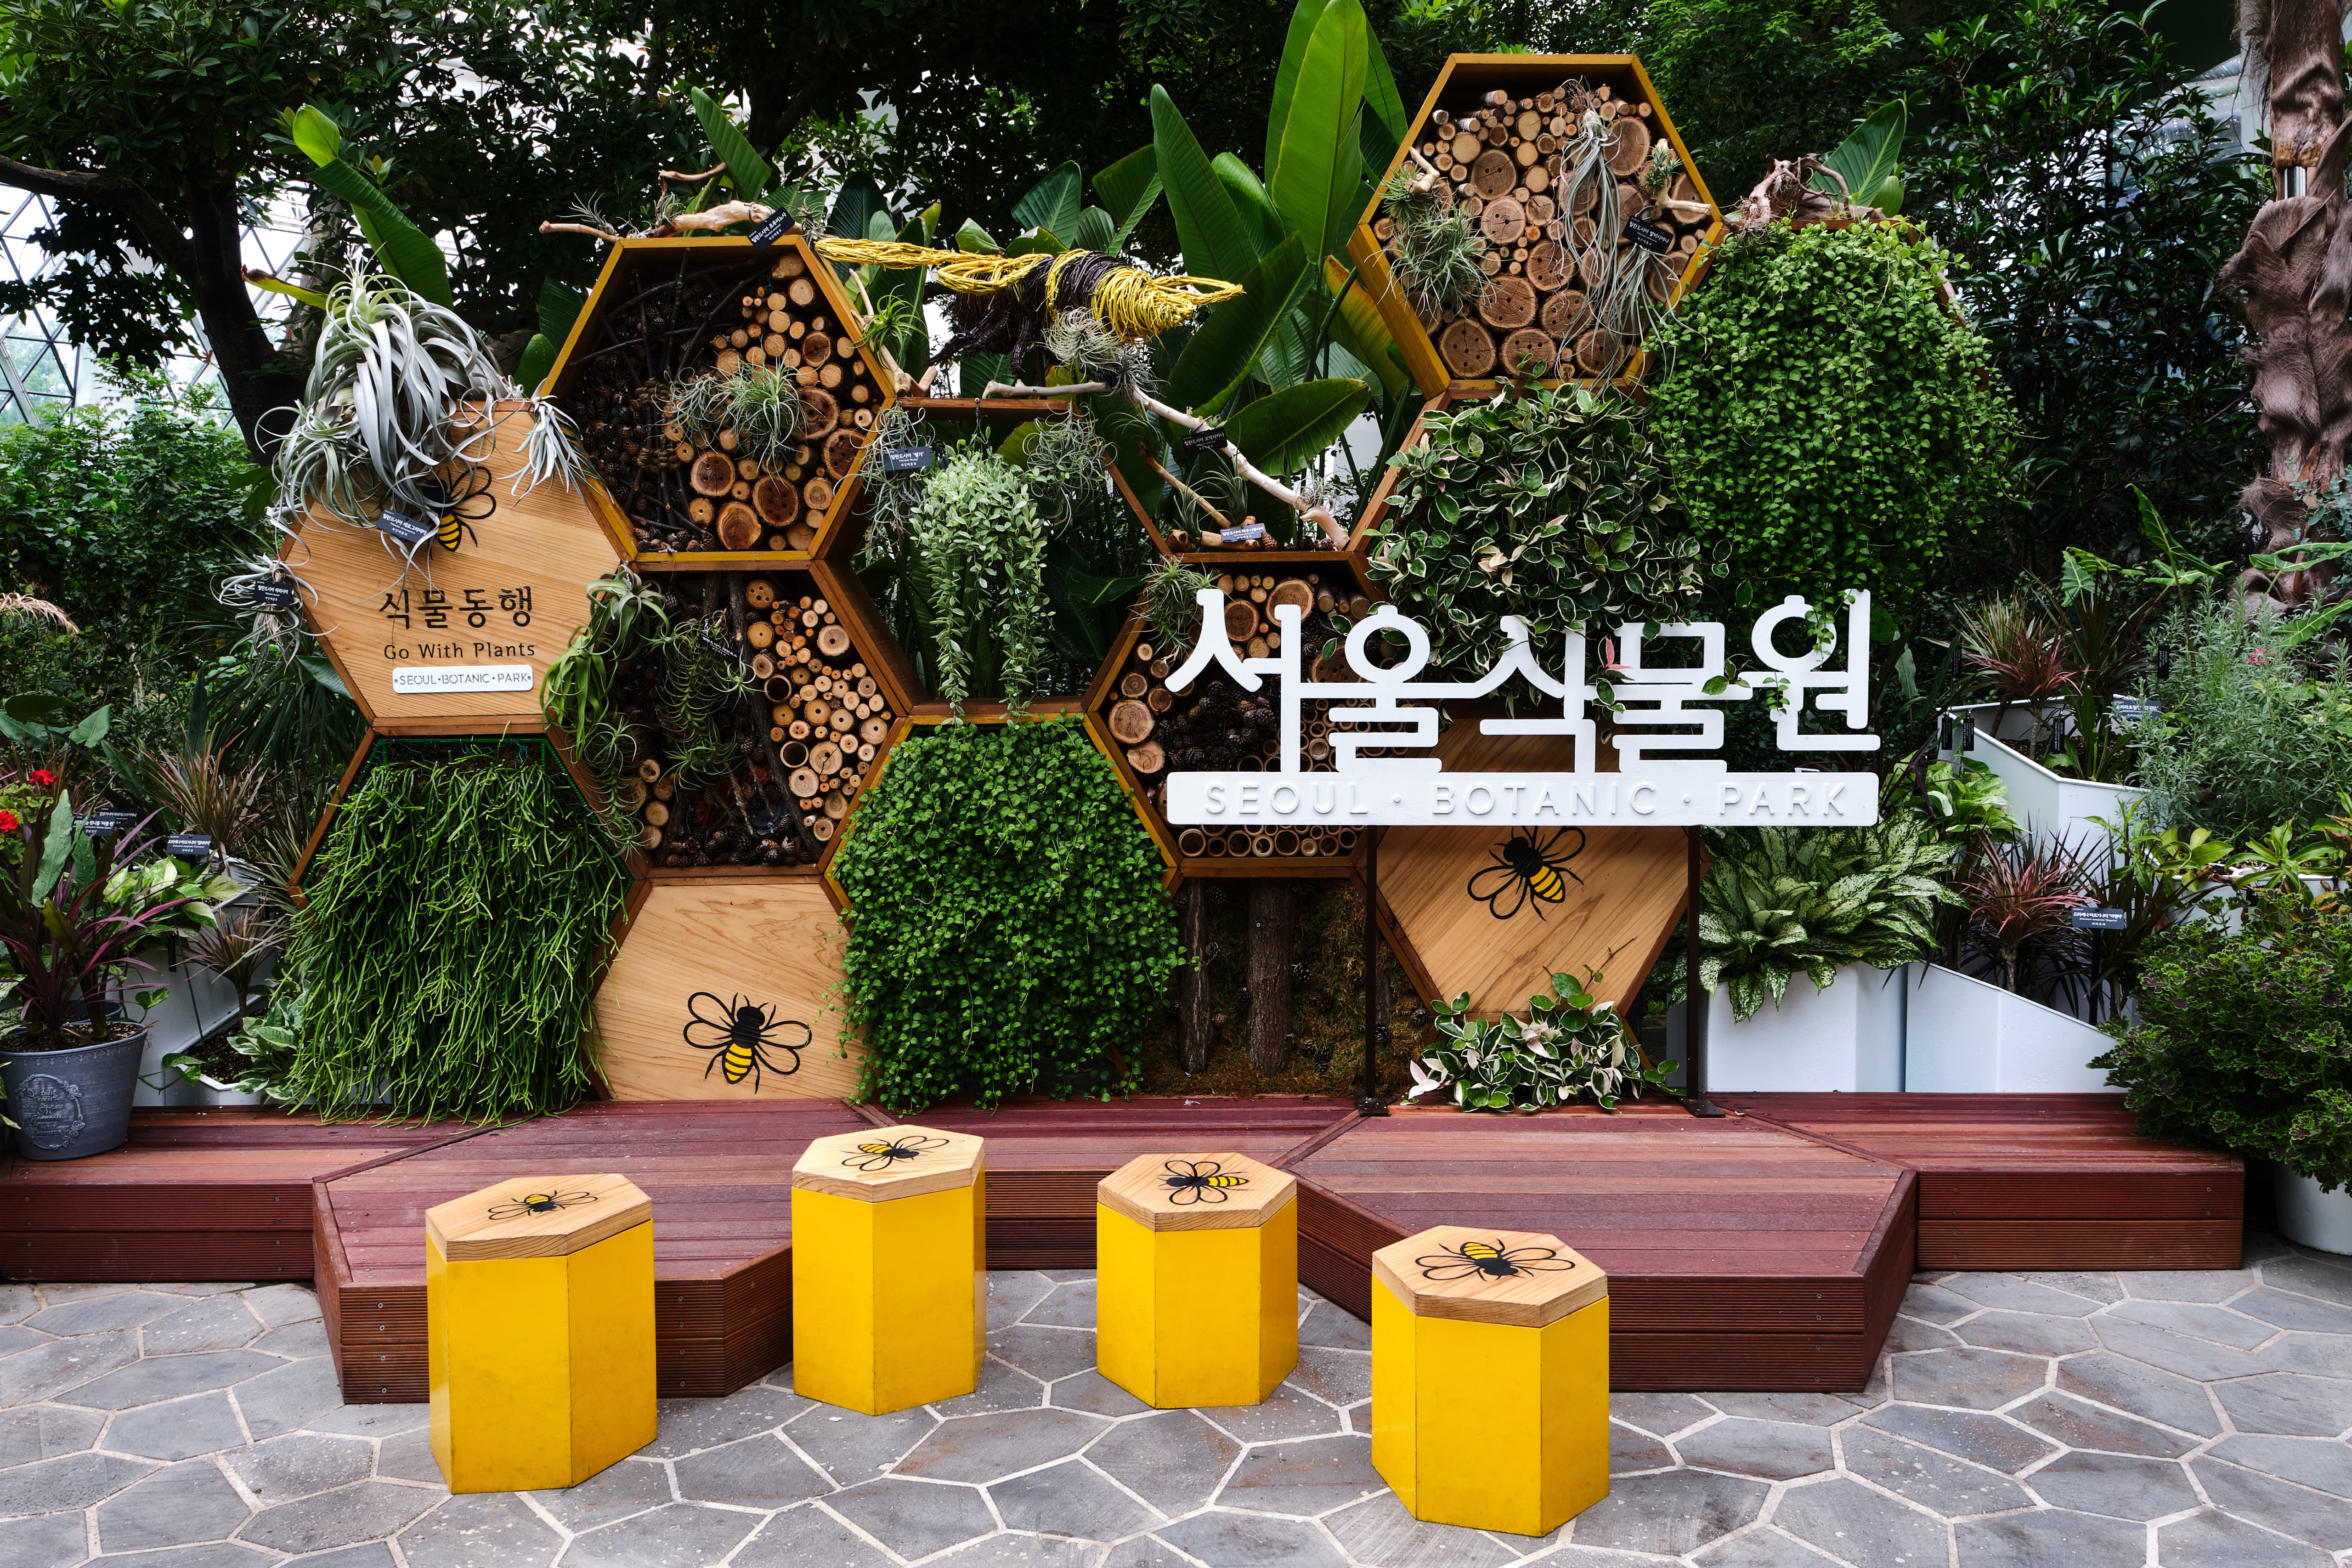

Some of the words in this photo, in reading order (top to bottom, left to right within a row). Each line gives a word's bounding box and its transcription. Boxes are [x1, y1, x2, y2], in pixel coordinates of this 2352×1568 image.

[379, 586, 532, 629] 식물동행
[384, 645, 409, 660] Go
[418, 643, 463, 658] With
[474, 642, 534, 657] Plants
[400, 675, 436, 685] SEOUL
[442, 674, 490, 684] BOTANIC
[498, 673, 528, 683] PARK
[1165, 589, 1881, 772] 서울식물원
[1205, 784, 1368, 814] SEOUL
[1433, 784, 1656, 815] BOTANIC
[1720, 783, 1846, 815] PARK
